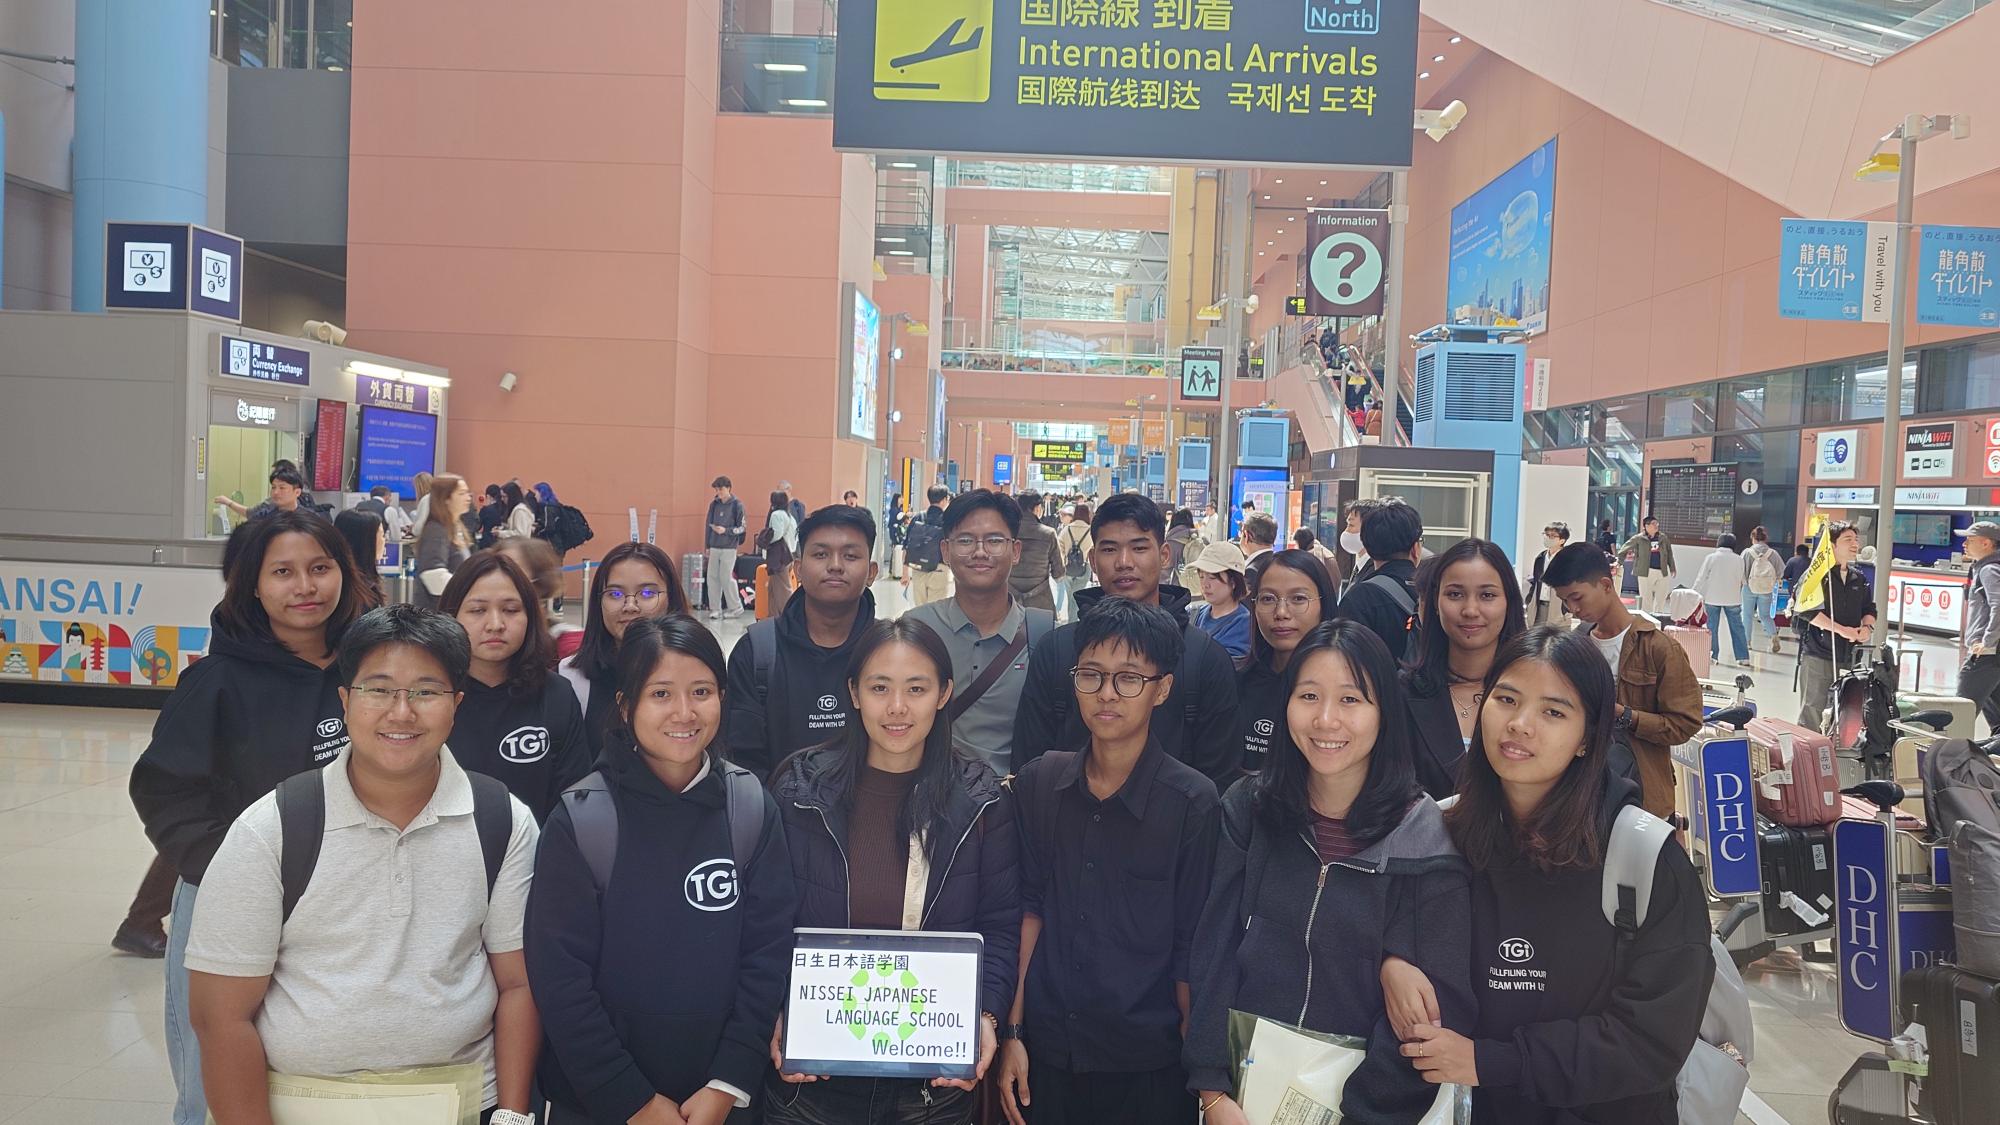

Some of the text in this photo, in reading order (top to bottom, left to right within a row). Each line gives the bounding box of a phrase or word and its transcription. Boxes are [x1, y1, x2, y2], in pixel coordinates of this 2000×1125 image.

[1020, 0, 1234, 31] 国際線 到着
[1310, 7, 1374, 29] North
[1019, 36, 1378, 76] International Arrivals
[1227, 82, 1377, 116] 국제선 도착
[1317, 214, 1378, 226] Information
[1800, 243, 1848, 266] 龍角散
[1939, 249, 1986, 272] 龍角散
[1792, 266, 1855, 289] ダイレクト
[1872, 235, 1889, 313] Travel with you
[252, 358, 277, 372] Currency
[278, 362, 303, 377] Exchange
[318, 720, 340, 735] TGi
[1257, 721, 1274, 734] TGi
[506, 731, 546, 757] TGi
[314, 750, 333, 762] DEAM
[1713, 772, 1747, 862] DHC
[690, 868, 738, 902] TGi
[1846, 864, 1879, 991] DHC
[1503, 942, 1530, 958] TGi
[794, 953, 909, 971] 日生日本語学園
[1489, 966, 1546, 979] FULLFILING YOUR
[799, 984, 938, 1004] NISSEI JAPANESE
[1488, 979, 1512, 990] DEAM
[1513, 981, 1536, 991] WITH
[826, 1008, 964, 1028] LANGUAGE SCHOOL
[871, 1039, 967, 1058] Welcome!!
